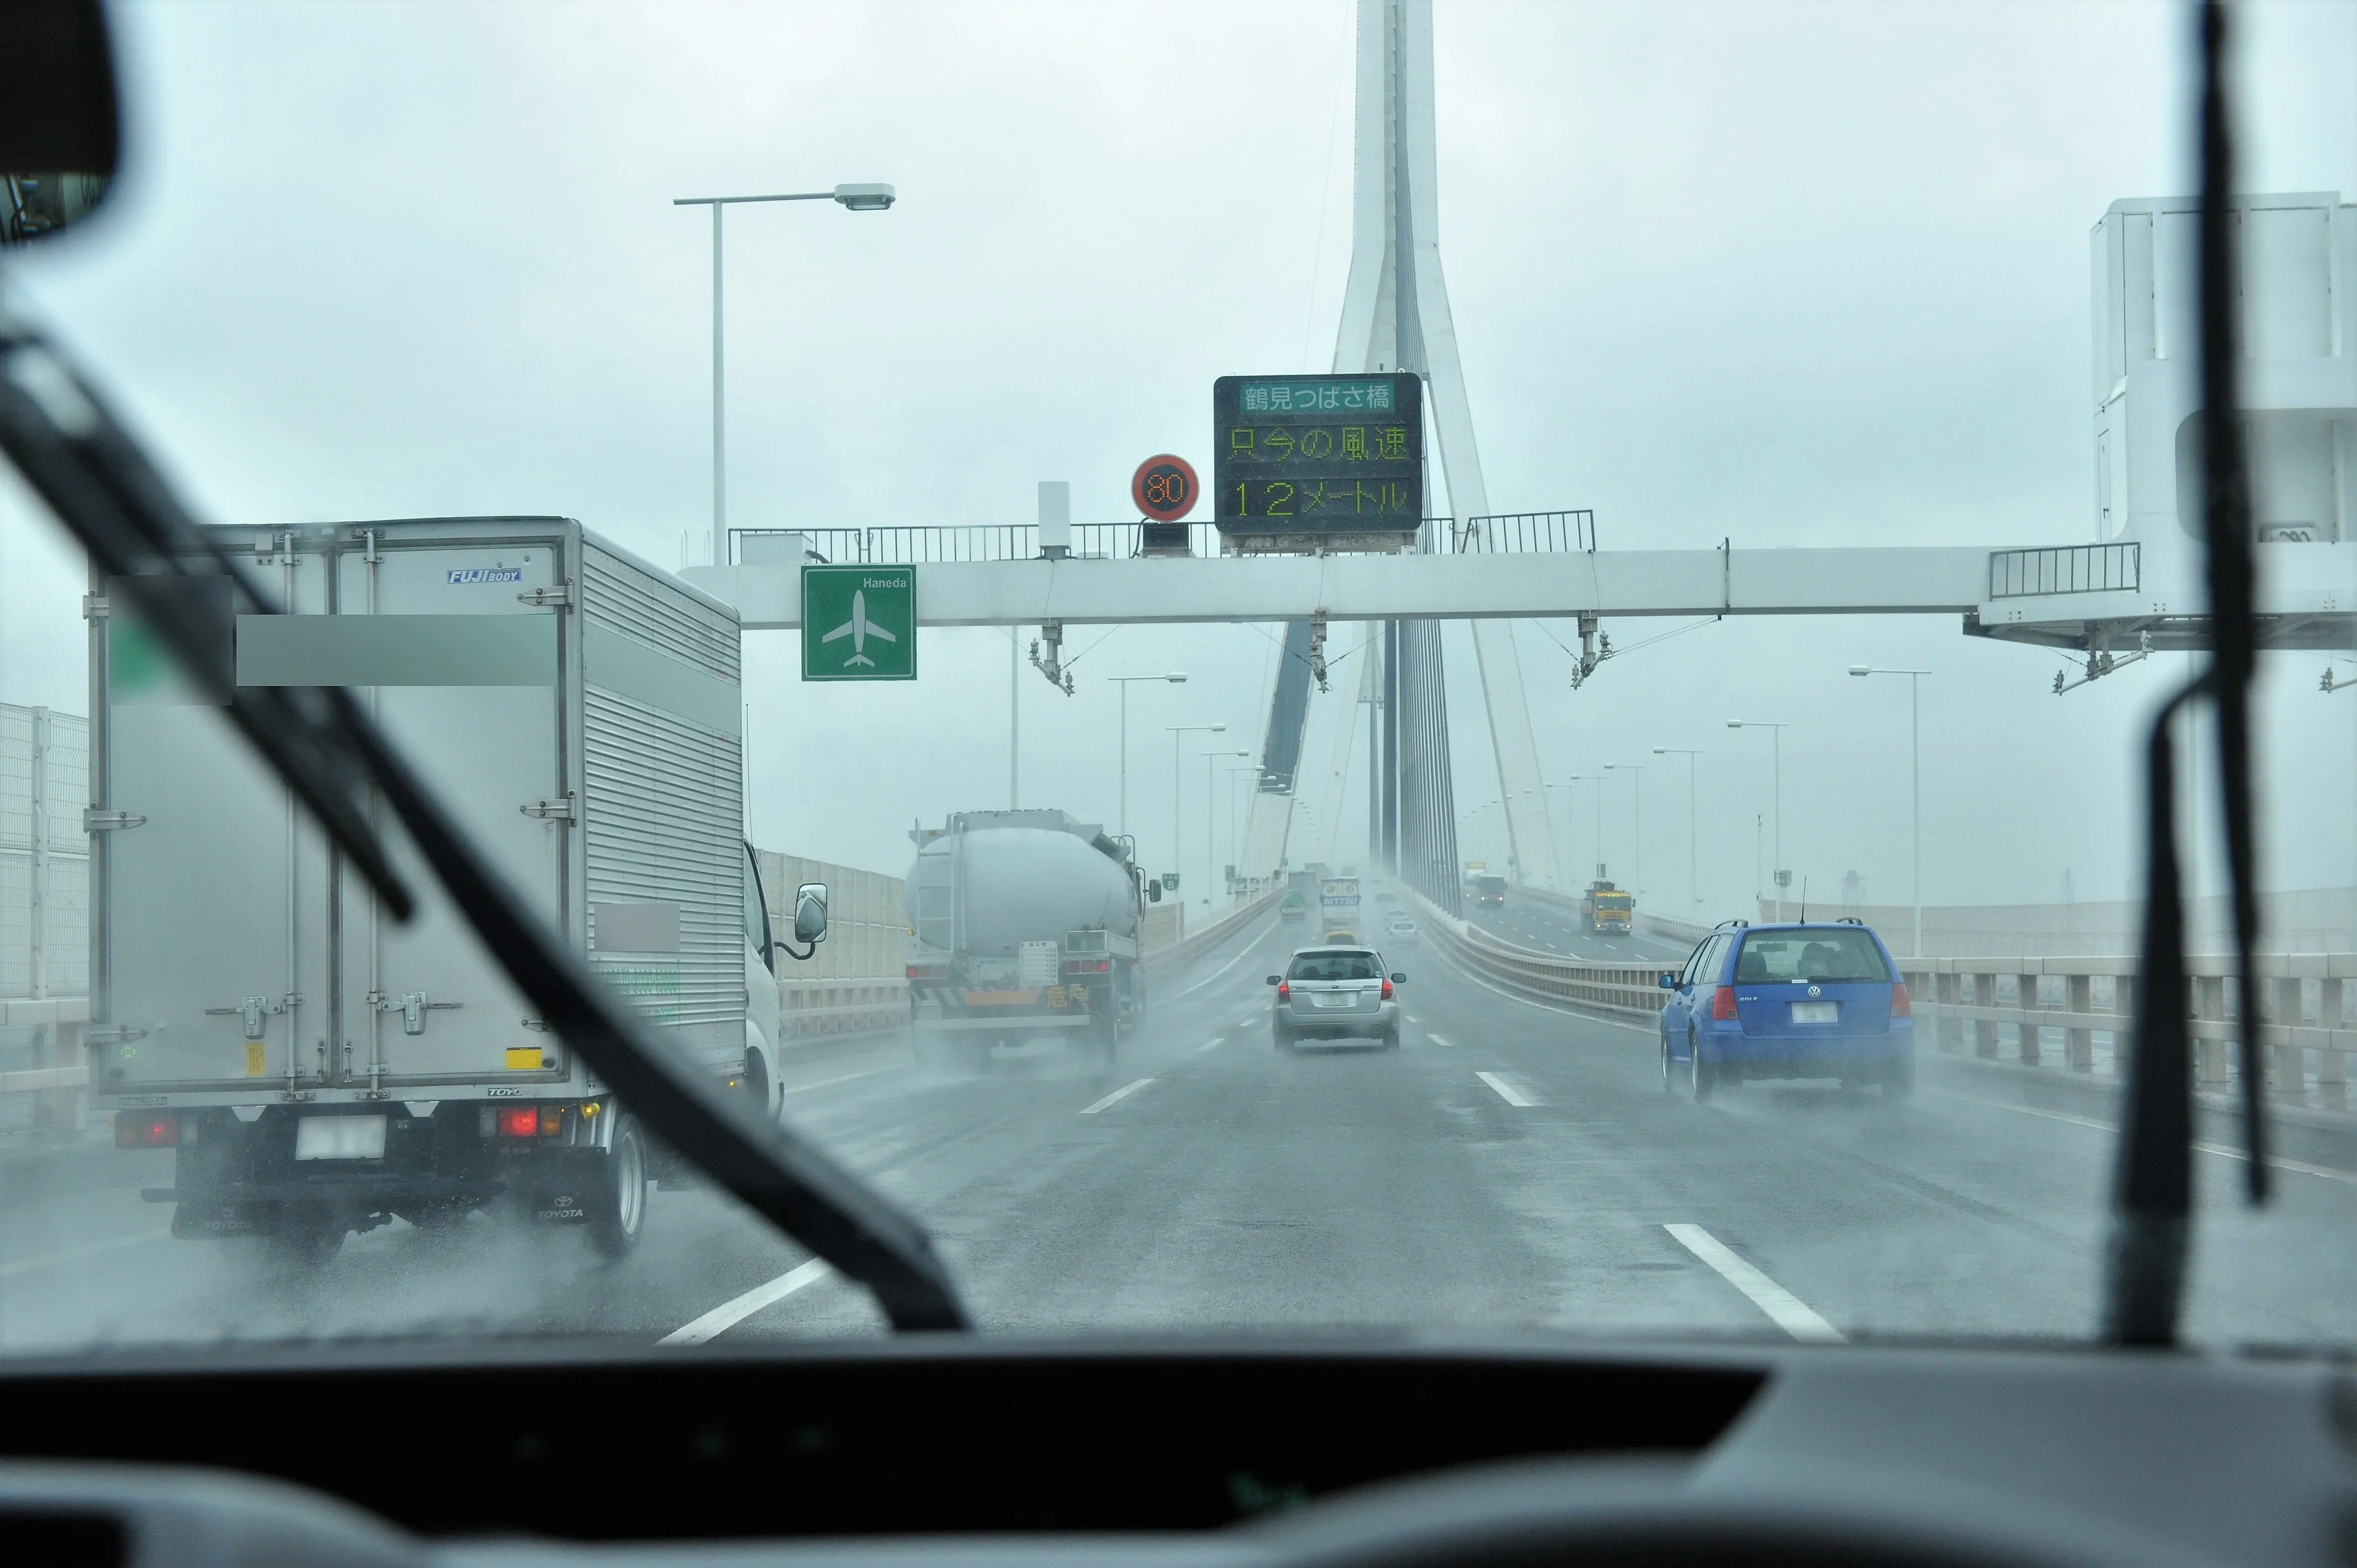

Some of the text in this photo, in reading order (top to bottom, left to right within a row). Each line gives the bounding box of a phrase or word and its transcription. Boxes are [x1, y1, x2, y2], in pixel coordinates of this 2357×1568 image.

[1245, 385, 1390, 410] 鶴見つばさ橋
[1227, 426, 1407, 462] 只今の風速
[1147, 474, 1183, 503] 80
[449, 570, 518, 584] FUJI BODY
[864, 577, 907, 588] Haneda
[1168, 881, 1174, 889] B
[1324, 897, 1357, 905] NITTSU
[537, 1209, 583, 1219] TOYOTA
